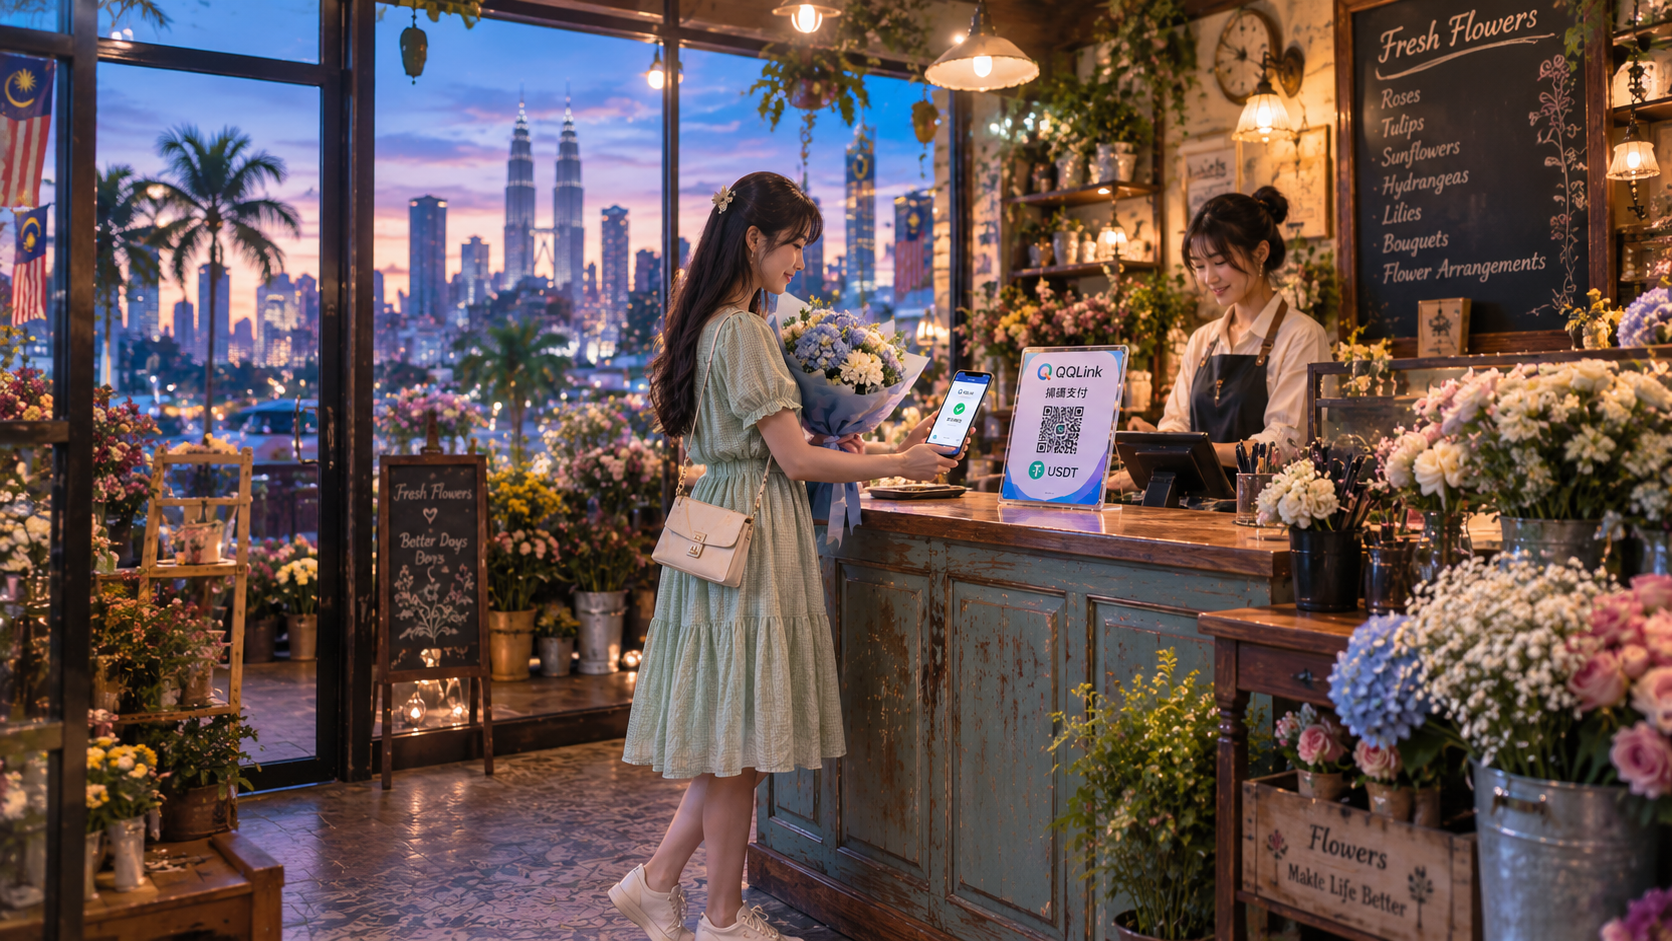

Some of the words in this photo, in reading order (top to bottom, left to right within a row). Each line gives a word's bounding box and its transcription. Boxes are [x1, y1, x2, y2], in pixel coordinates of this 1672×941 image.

[1378, 20, 1440, 63] Fresh
[1449, 9, 1538, 48] Flowers
[1381, 87, 1421, 109] Roses
[1381, 115, 1425, 140] Tulips
[1381, 139, 1460, 169] Sunflowers
[1382, 169, 1469, 199] Hydrangeas
[1382, 203, 1422, 225] Lilies
[1383, 262, 1432, 284] Flower
[1436, 252, 1547, 282] Arrangements
[1056, 364, 1103, 378] QQLink
[1047, 466, 1079, 478] USDT
[393, 482, 427, 502] Fresh
[431, 482, 473, 500] Flowers
[1307, 824, 1388, 870] Flowers
[1330, 874, 1357, 903] Life
[1362, 885, 1407, 917] Better
